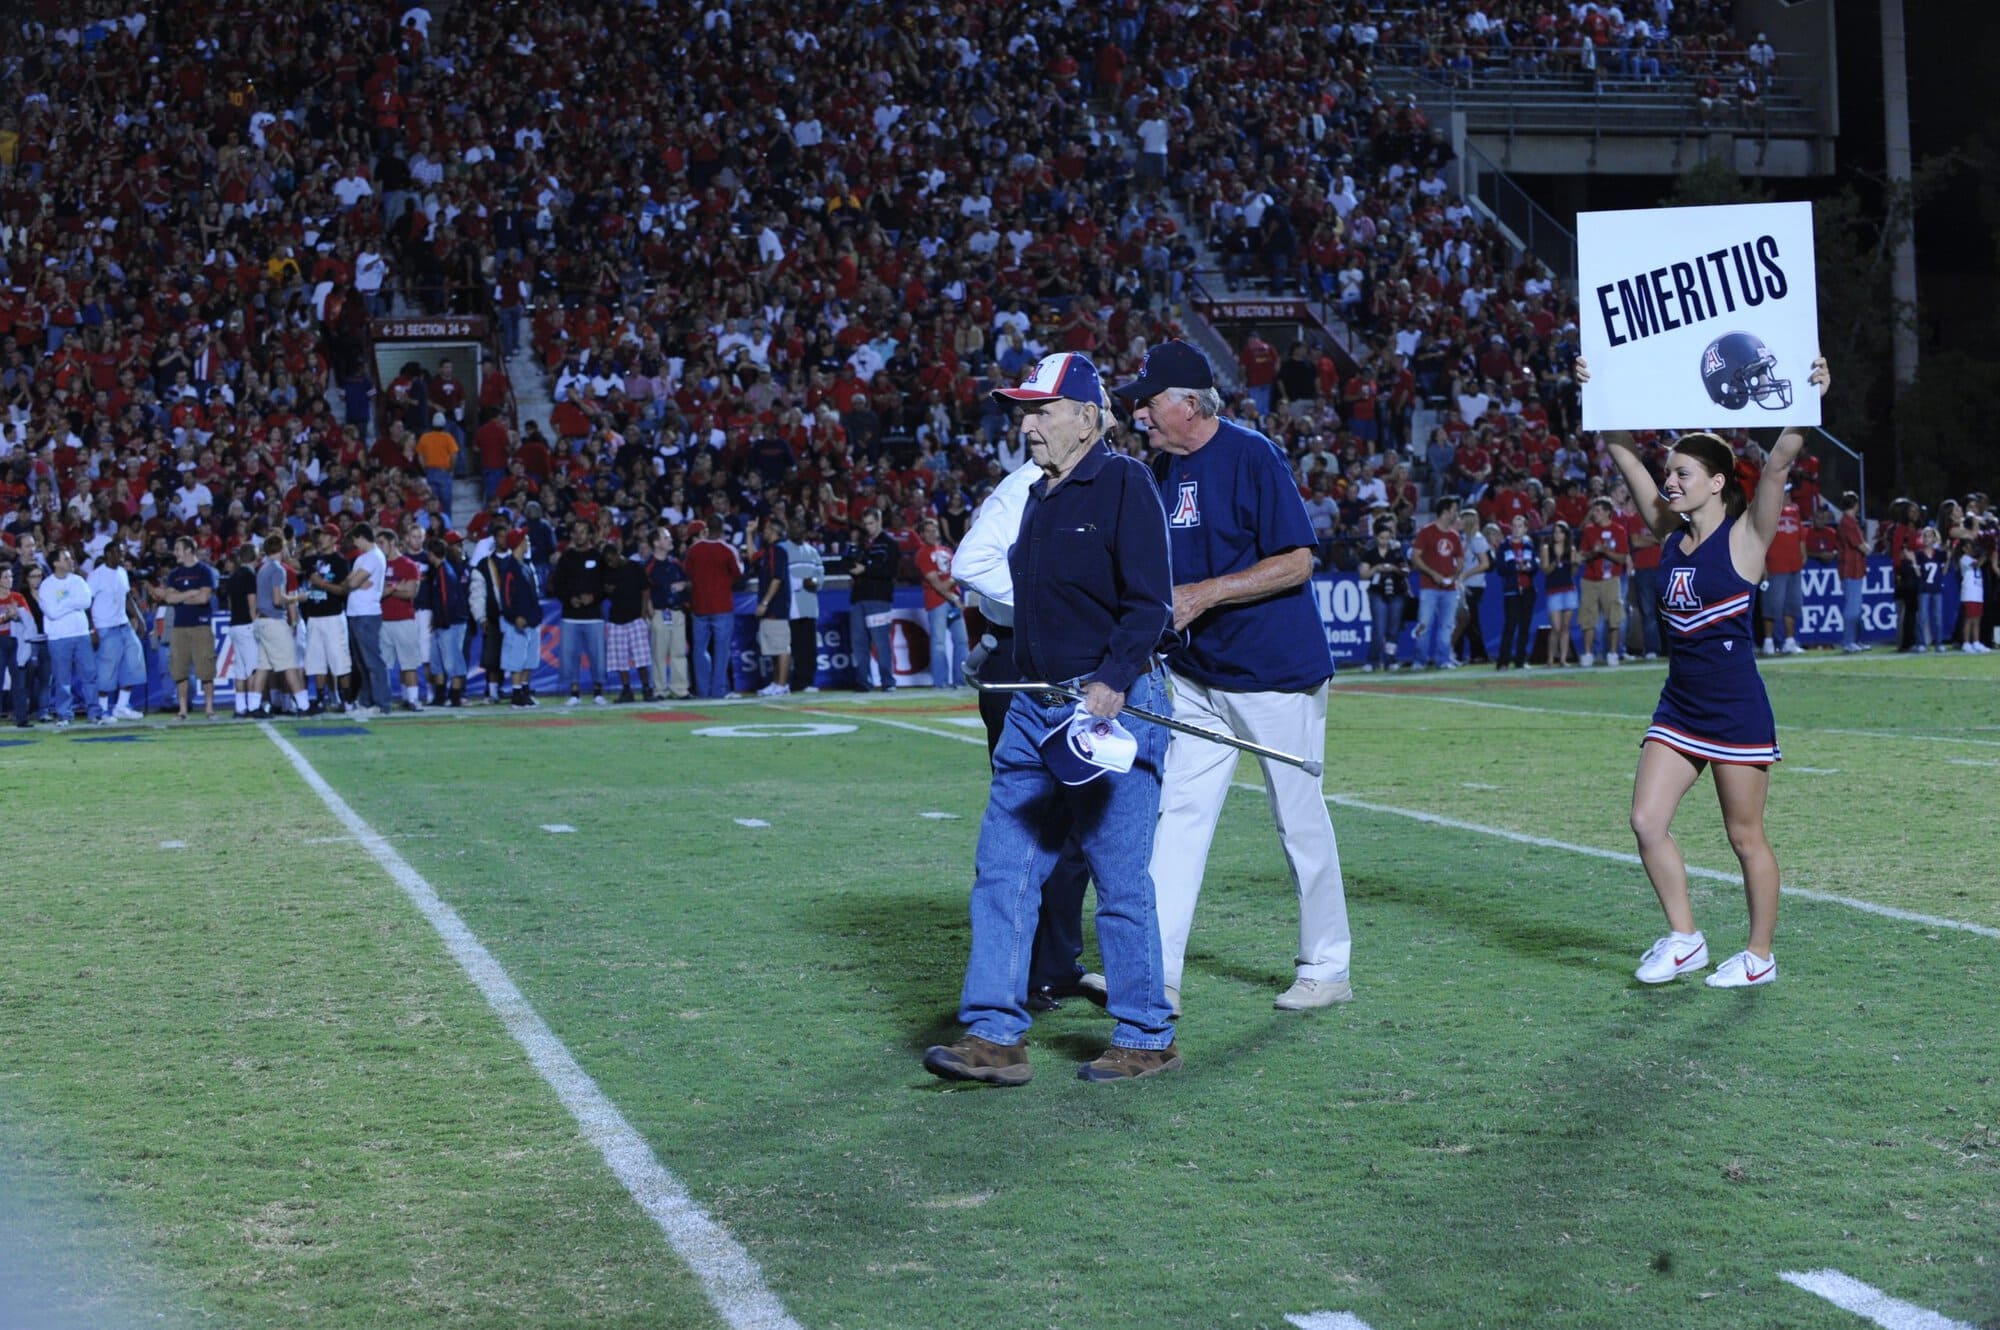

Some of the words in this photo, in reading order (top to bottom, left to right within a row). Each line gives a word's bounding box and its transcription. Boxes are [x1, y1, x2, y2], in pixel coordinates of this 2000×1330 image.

[1596, 235, 1788, 347] EMERITUS
[1235, 303, 1272, 317] SECTION
[407, 323, 446, 337] SECTION
[1703, 343, 1726, 378] A
[1169, 481, 1201, 528] A
[1662, 567, 1703, 611] A
[1925, 562, 1938, 584] 7
